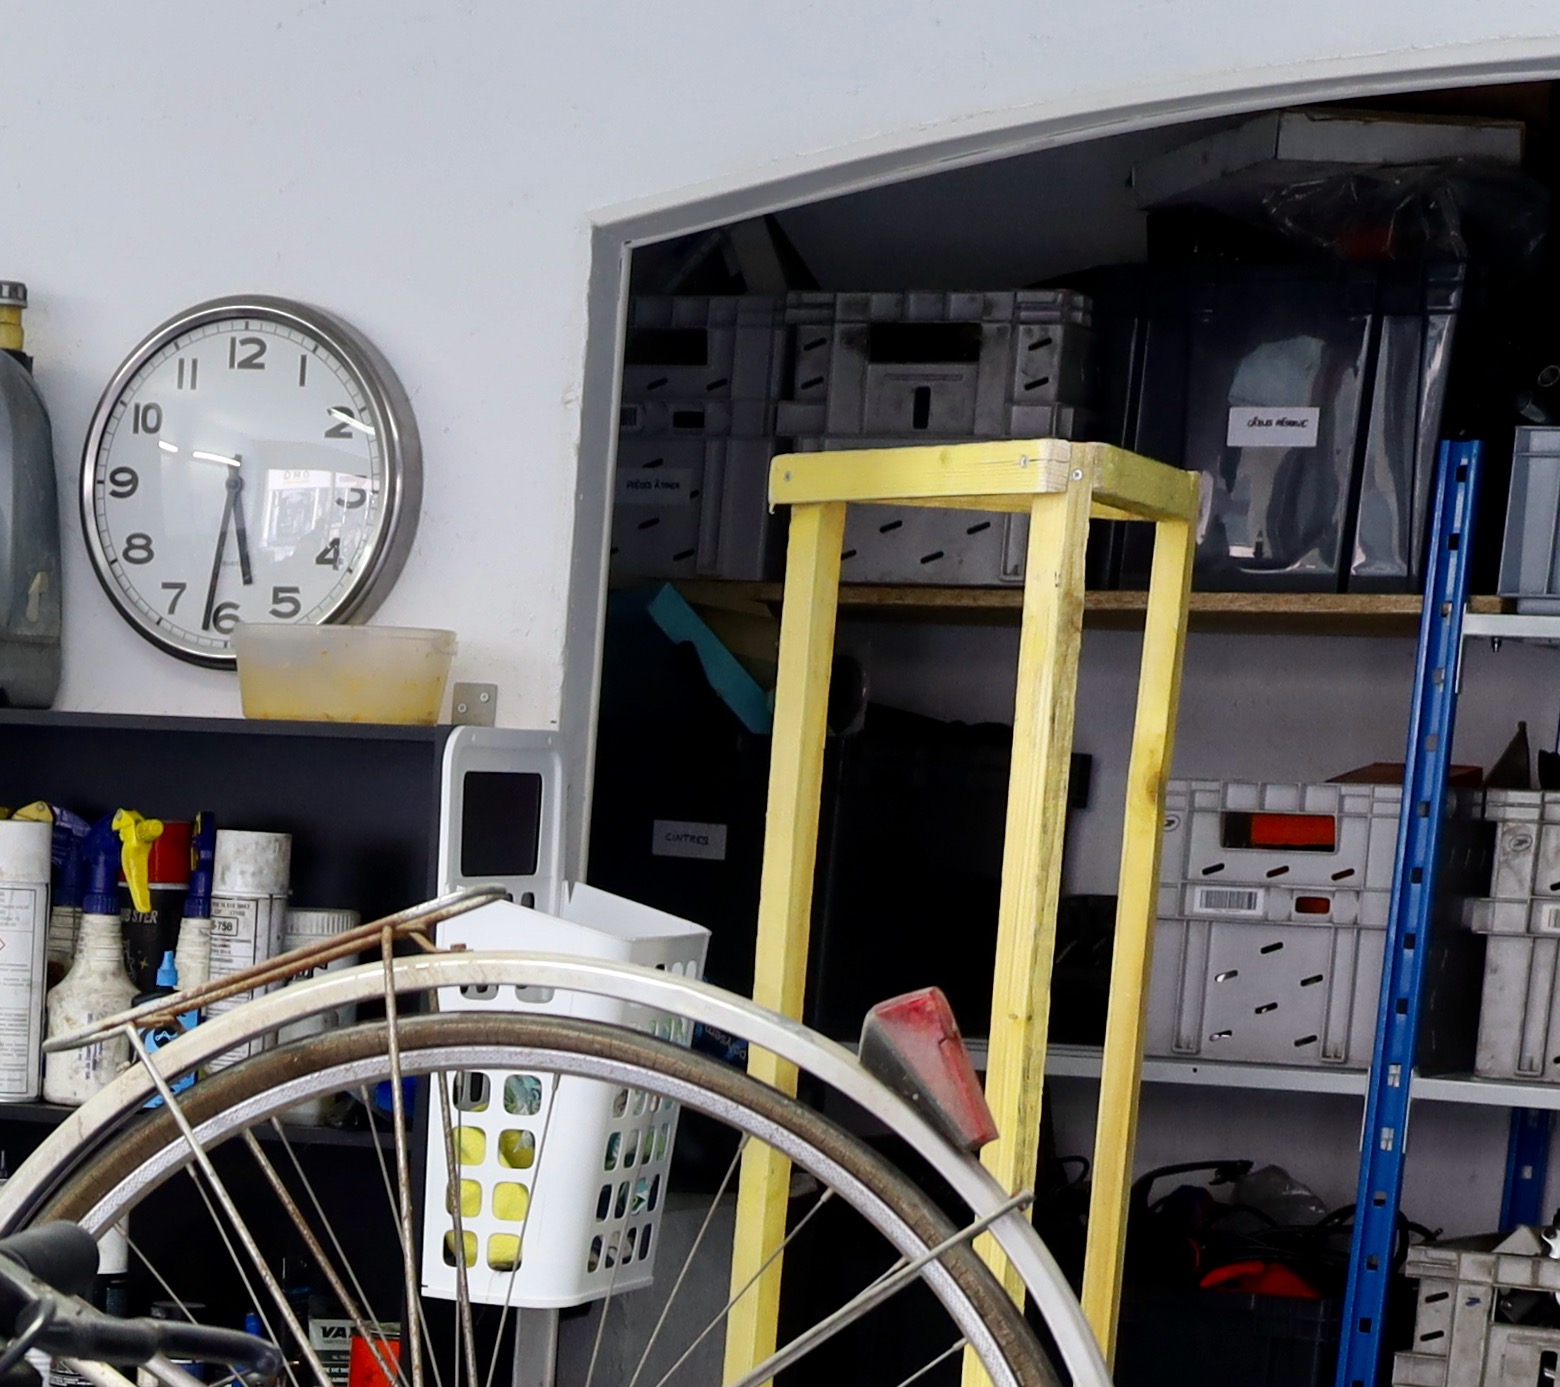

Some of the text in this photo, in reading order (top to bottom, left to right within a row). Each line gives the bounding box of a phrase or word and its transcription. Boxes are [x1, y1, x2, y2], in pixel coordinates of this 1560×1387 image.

[229, 337, 267, 369] 12
[177, 358, 198, 390] 11
[298, 354, 307, 387] 1
[132, 402, 162, 434] 10
[324, 405, 355, 438] 2
[108, 466, 139, 498] 9
[122, 533, 154, 565] 8
[315, 537, 343, 570] 4
[161, 582, 187, 614] 7
[269, 586, 301, 618] 5
[211, 601, 240, 634] 6
[664, 832, 709, 846] CINTRES
